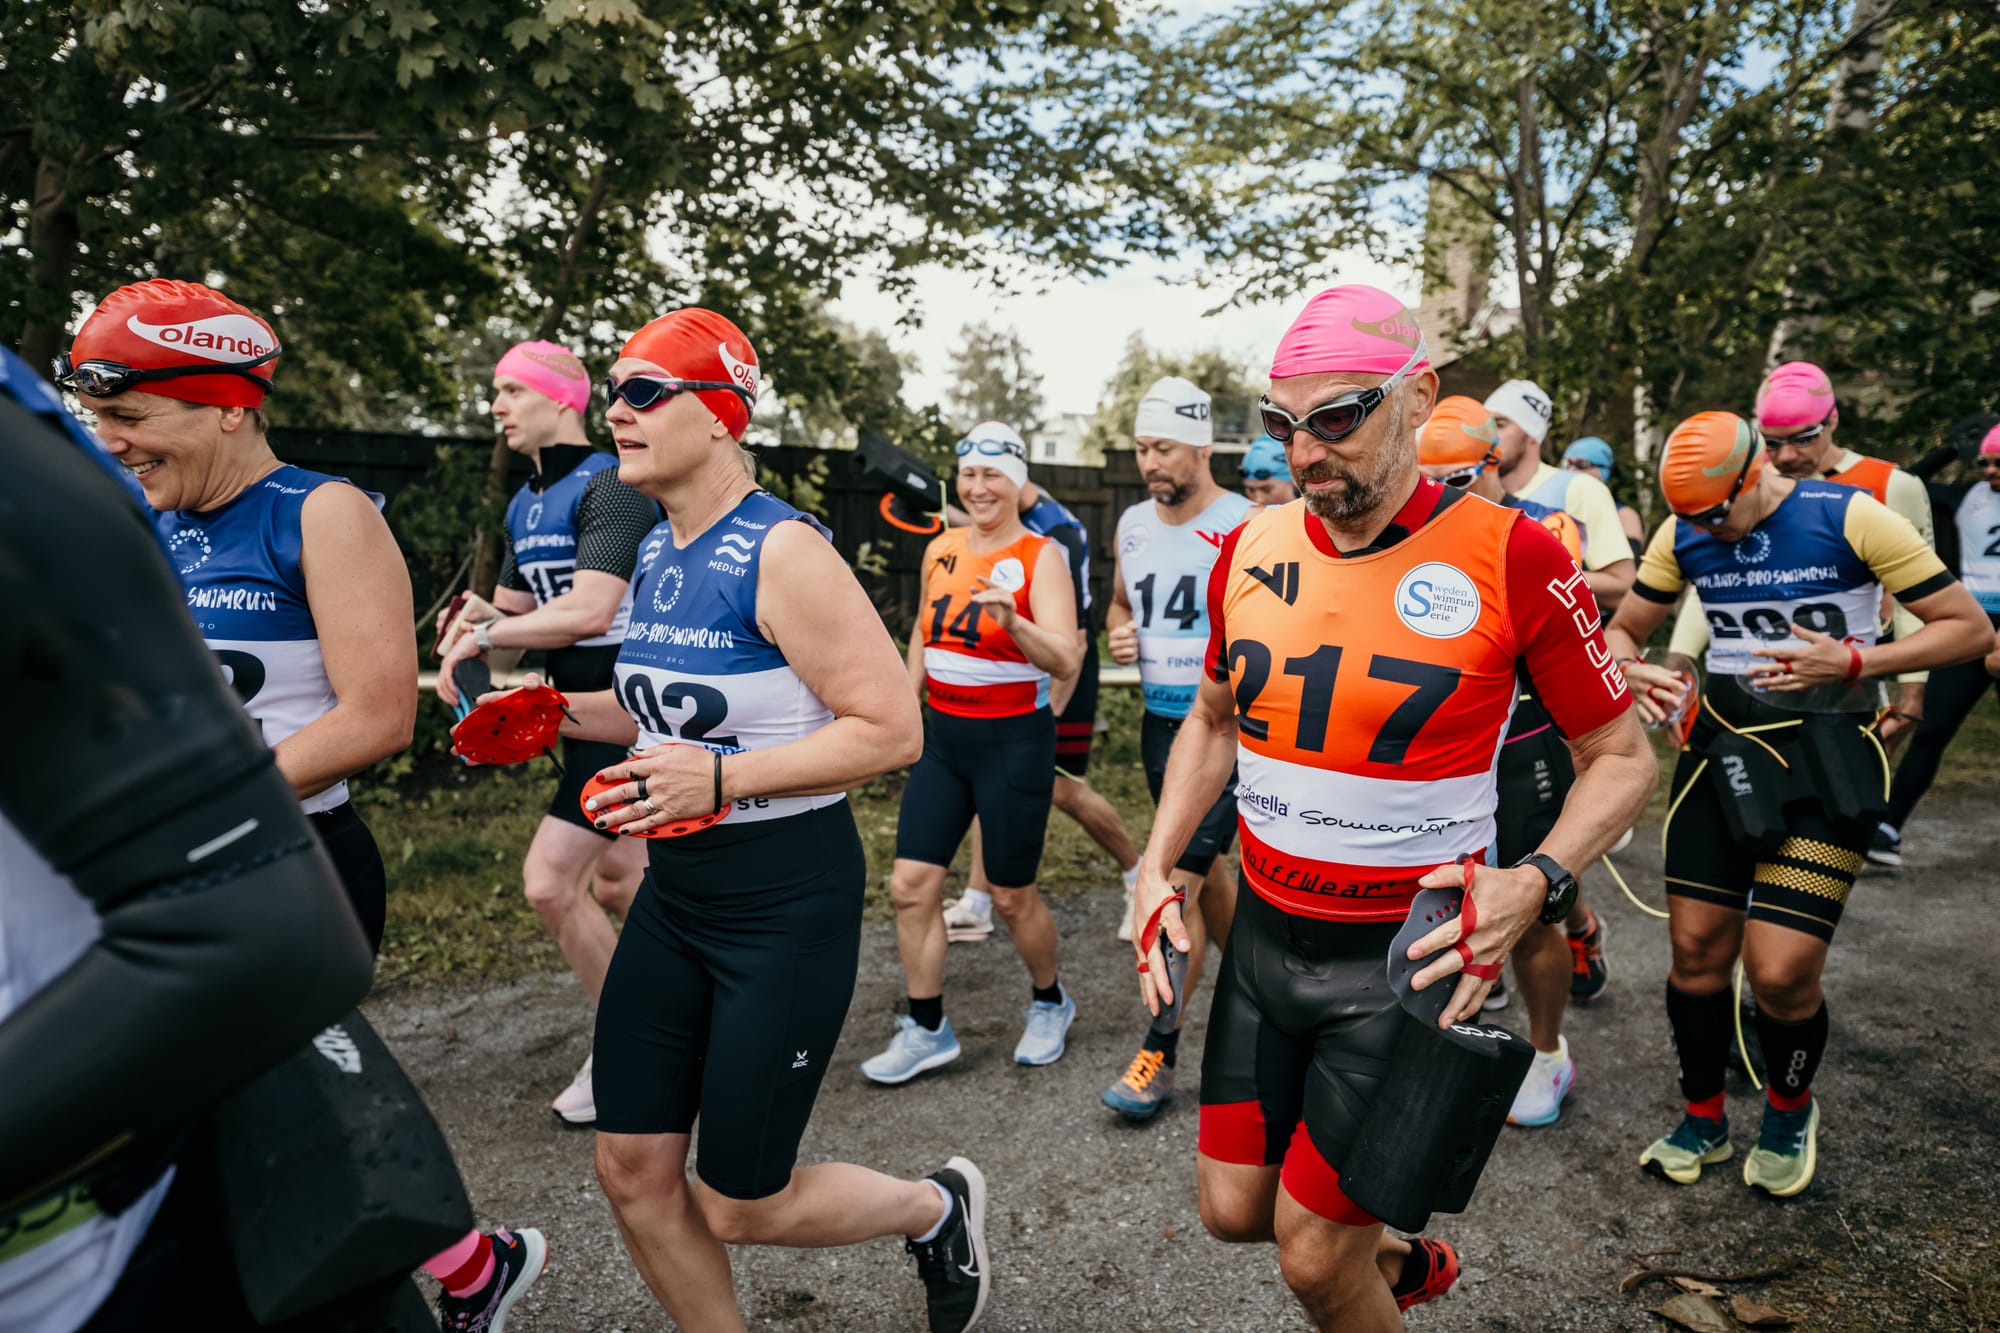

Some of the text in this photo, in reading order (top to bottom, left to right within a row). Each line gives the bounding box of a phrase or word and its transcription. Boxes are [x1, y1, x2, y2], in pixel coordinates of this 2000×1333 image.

[708, 560, 747, 577] MEDLEY
[187, 586, 276, 611] SWIMRUN
[1134, 573, 1200, 630] 14
[666, 625, 734, 648] SWIMRUN
[931, 593, 983, 649] 14
[1228, 638, 1463, 766] 217
